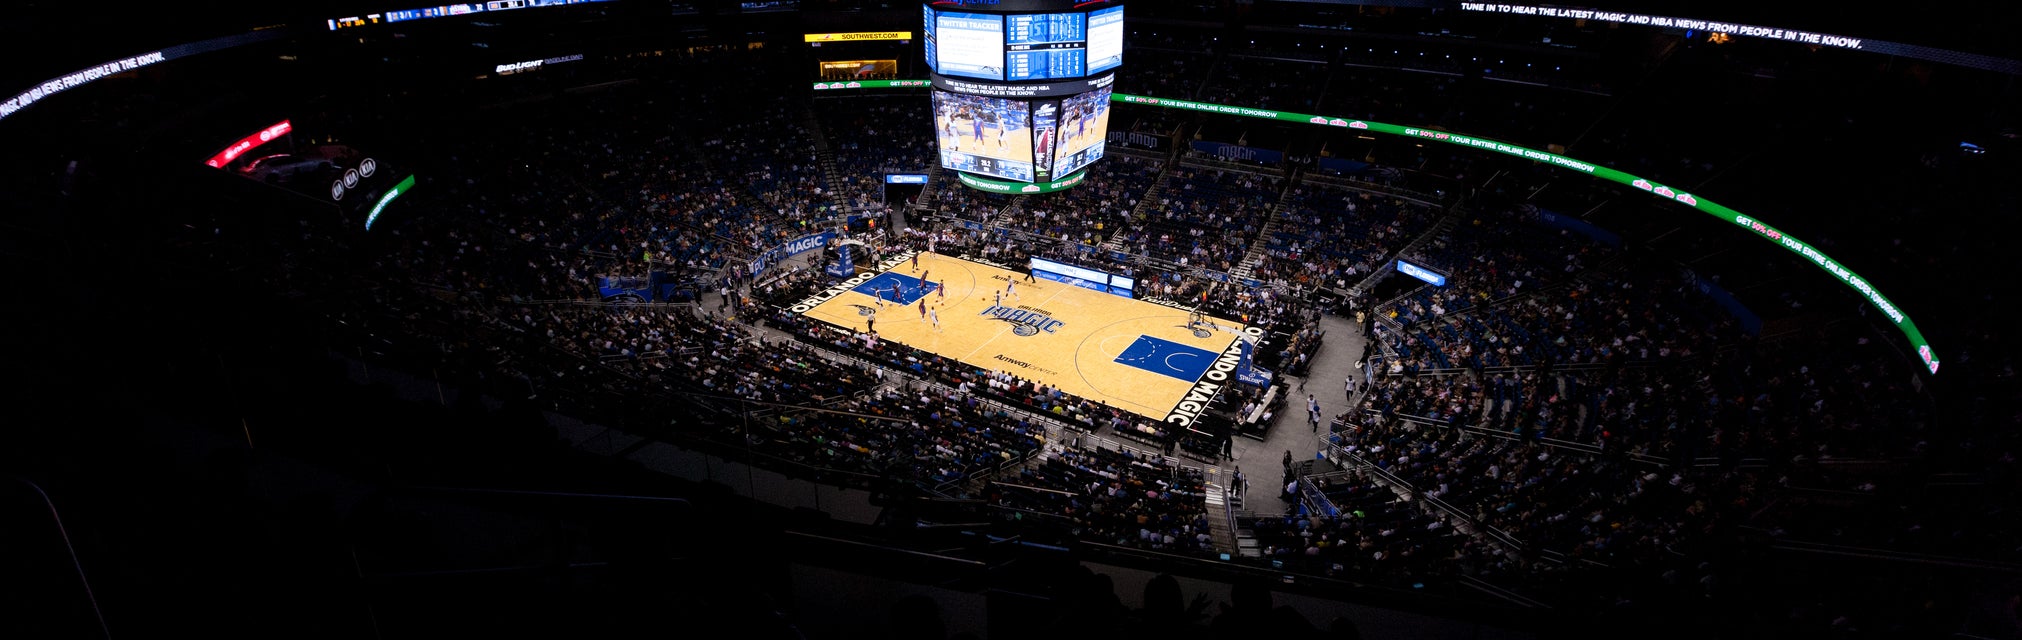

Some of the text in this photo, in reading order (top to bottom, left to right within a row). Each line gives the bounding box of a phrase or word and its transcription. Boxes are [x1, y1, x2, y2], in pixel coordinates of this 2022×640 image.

[939, 19, 999, 30] TWITTER TRACKER
[1461, 2, 1862, 49] TUNE IN TO HEAR THE LATEST MAGIC AND NBA NEWS FROM PEOPLE IN THE KNOW.
[62, 73, 85, 88] FROM
[84, 65, 112, 81] PEOPLE
[120, 58, 138, 71] THE
[1160, 99, 1176, 107] YOUR
[1176, 101, 1196, 109] ENTIRE
[1197, 104, 1218, 112] ONLINE
[1219, 106, 1240, 114] ORDER
[1240, 108, 1277, 118] TOMORROW
[1108, 131, 1158, 148] ORLANDO
[1218, 145, 1256, 161] MAGIC
[1405, 128, 1596, 173] GET 50% OFF YOUR ENTIRE ONLINE ORDER TOMORROW
[977, 181, 1010, 191] TOMORROW
[787, 236, 824, 254] MAGIC
[1736, 215, 1904, 324] GET 50% OFF YOUR ENTIRE ONLINE ORDER TOMORROW
[791, 272, 876, 313] ORLANDO
[1017, 304, 1052, 316] ORLANDO
[977, 305, 1066, 335] MAGIC
[994, 354, 1031, 369] Amway
[1167, 327, 1264, 427] OLANDO MAGIC
